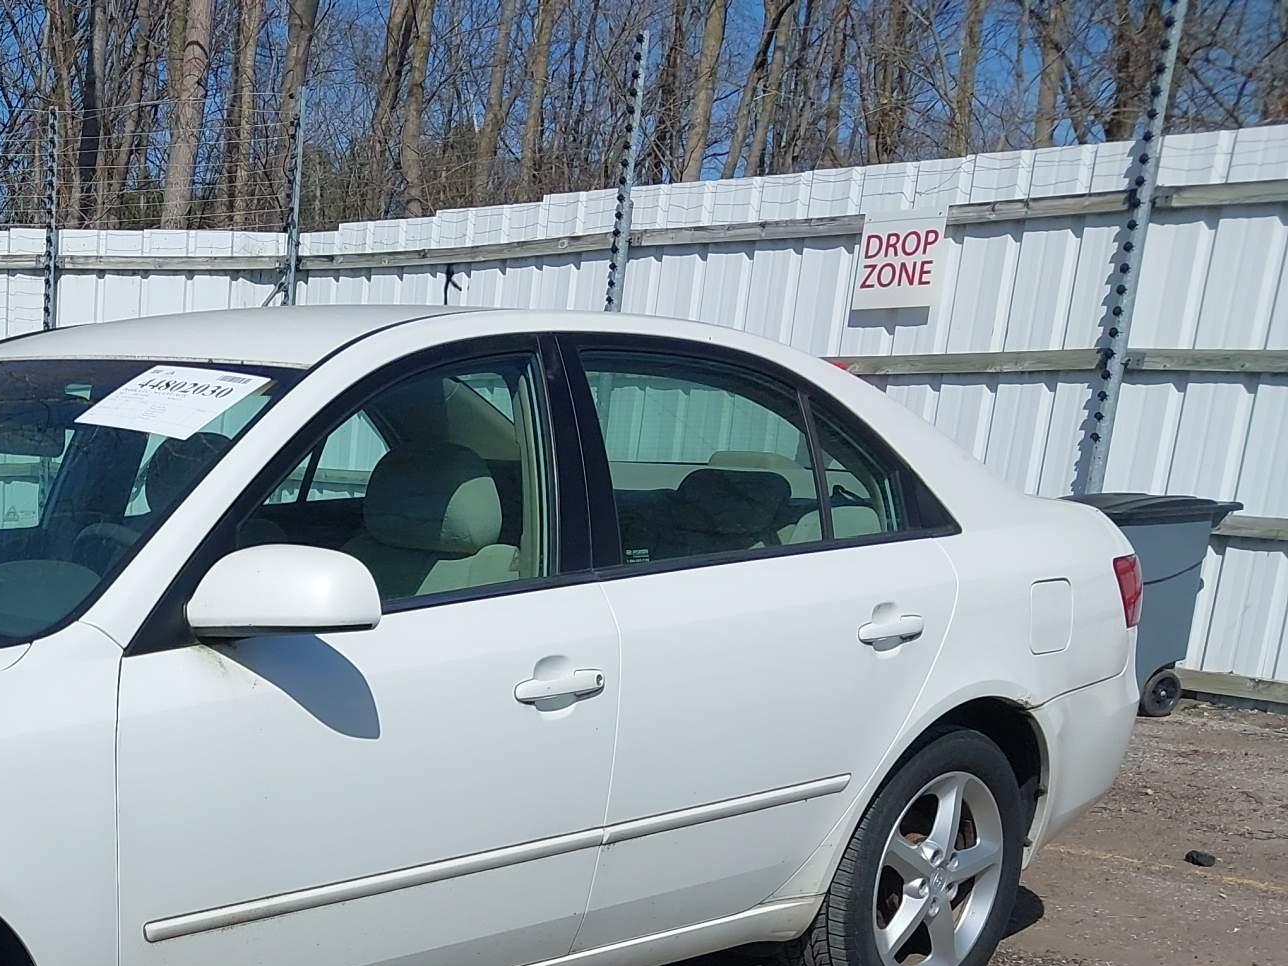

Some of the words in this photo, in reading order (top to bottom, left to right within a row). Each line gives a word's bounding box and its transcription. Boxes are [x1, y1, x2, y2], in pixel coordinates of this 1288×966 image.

[864, 230, 939, 259] DROP
[860, 260, 934, 289] ZONE
[138, 379, 234, 399] 44802030
